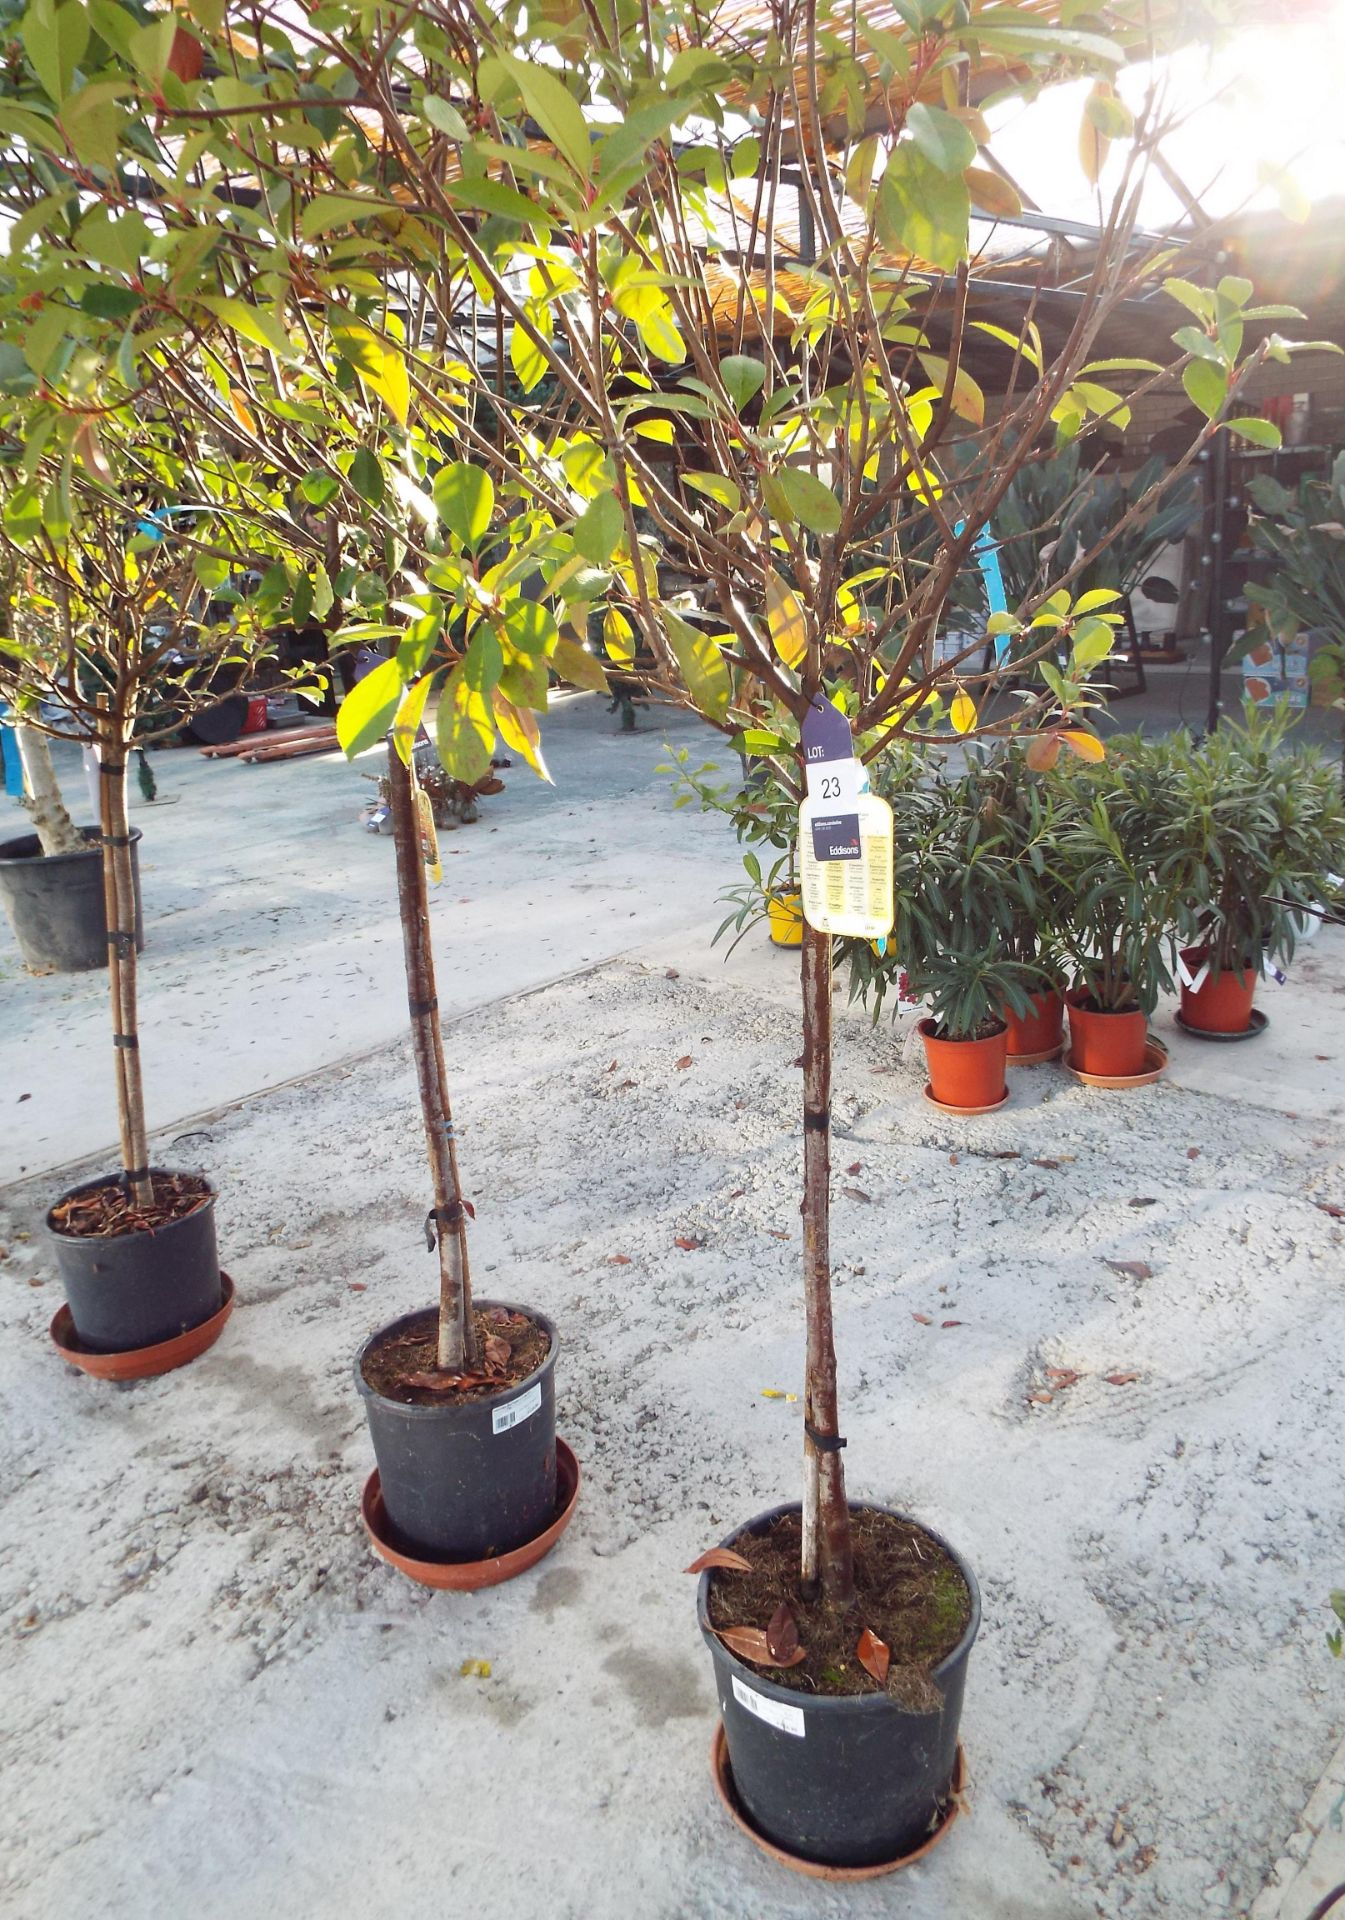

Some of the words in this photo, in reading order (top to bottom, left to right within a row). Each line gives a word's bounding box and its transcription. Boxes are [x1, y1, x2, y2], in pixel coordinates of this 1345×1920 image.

[807, 746, 825, 759] LOT:
[821, 776, 841, 799] 23
[829, 845, 859, 856] Eddisons
